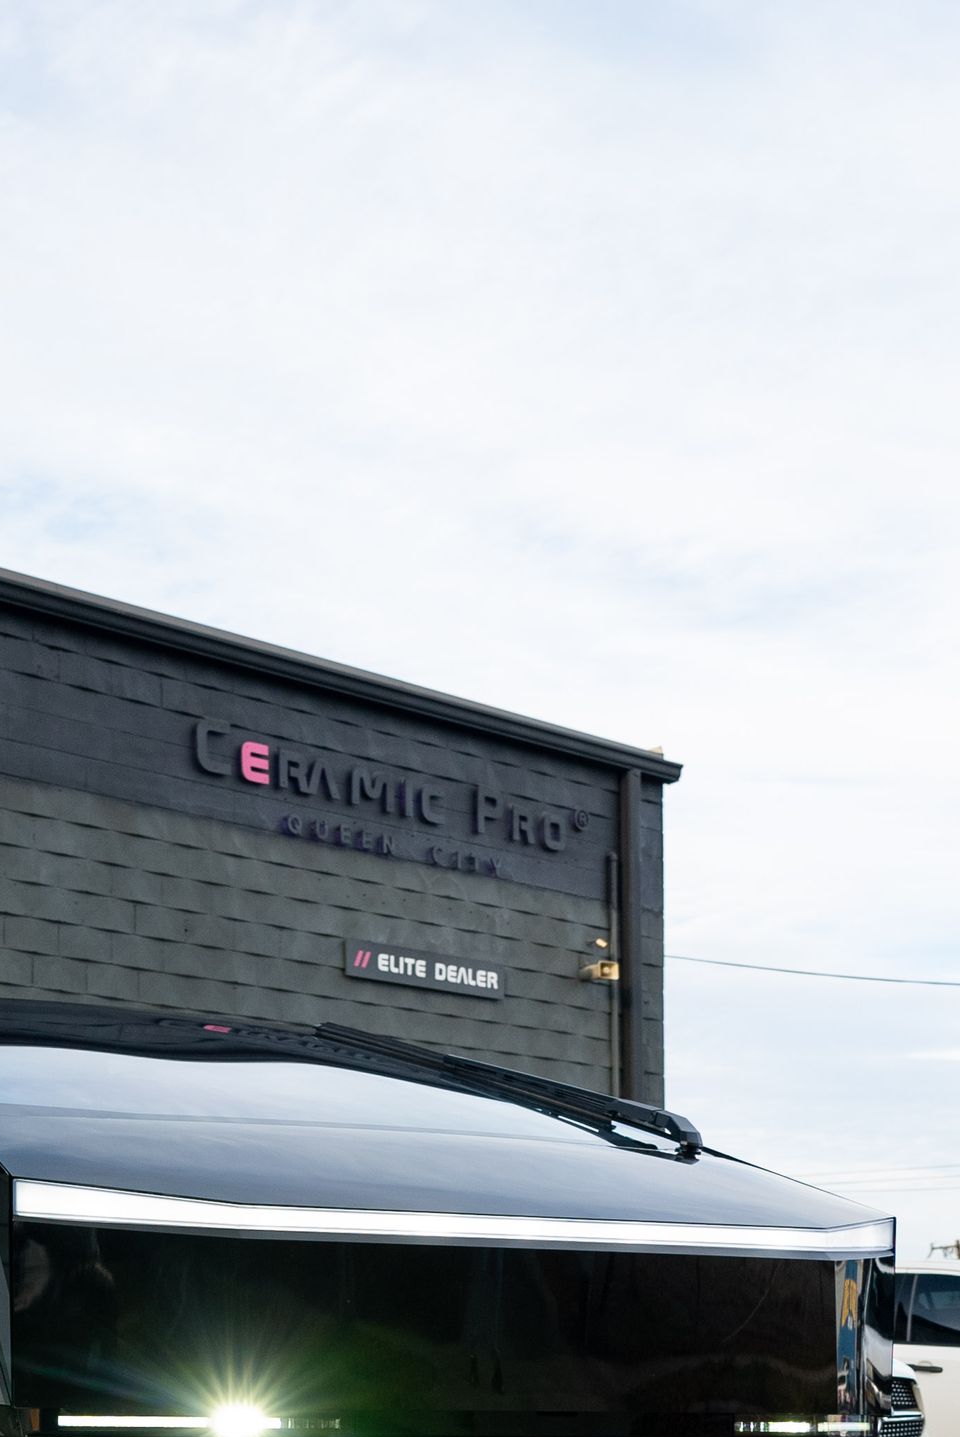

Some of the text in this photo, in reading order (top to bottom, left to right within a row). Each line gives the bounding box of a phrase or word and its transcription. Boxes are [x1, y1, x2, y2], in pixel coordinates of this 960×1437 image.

[196, 717, 446, 826] CERAMIC
[286, 813, 504, 878] QUEEN CITY
[377, 953, 499, 990] ELITE DEALER
